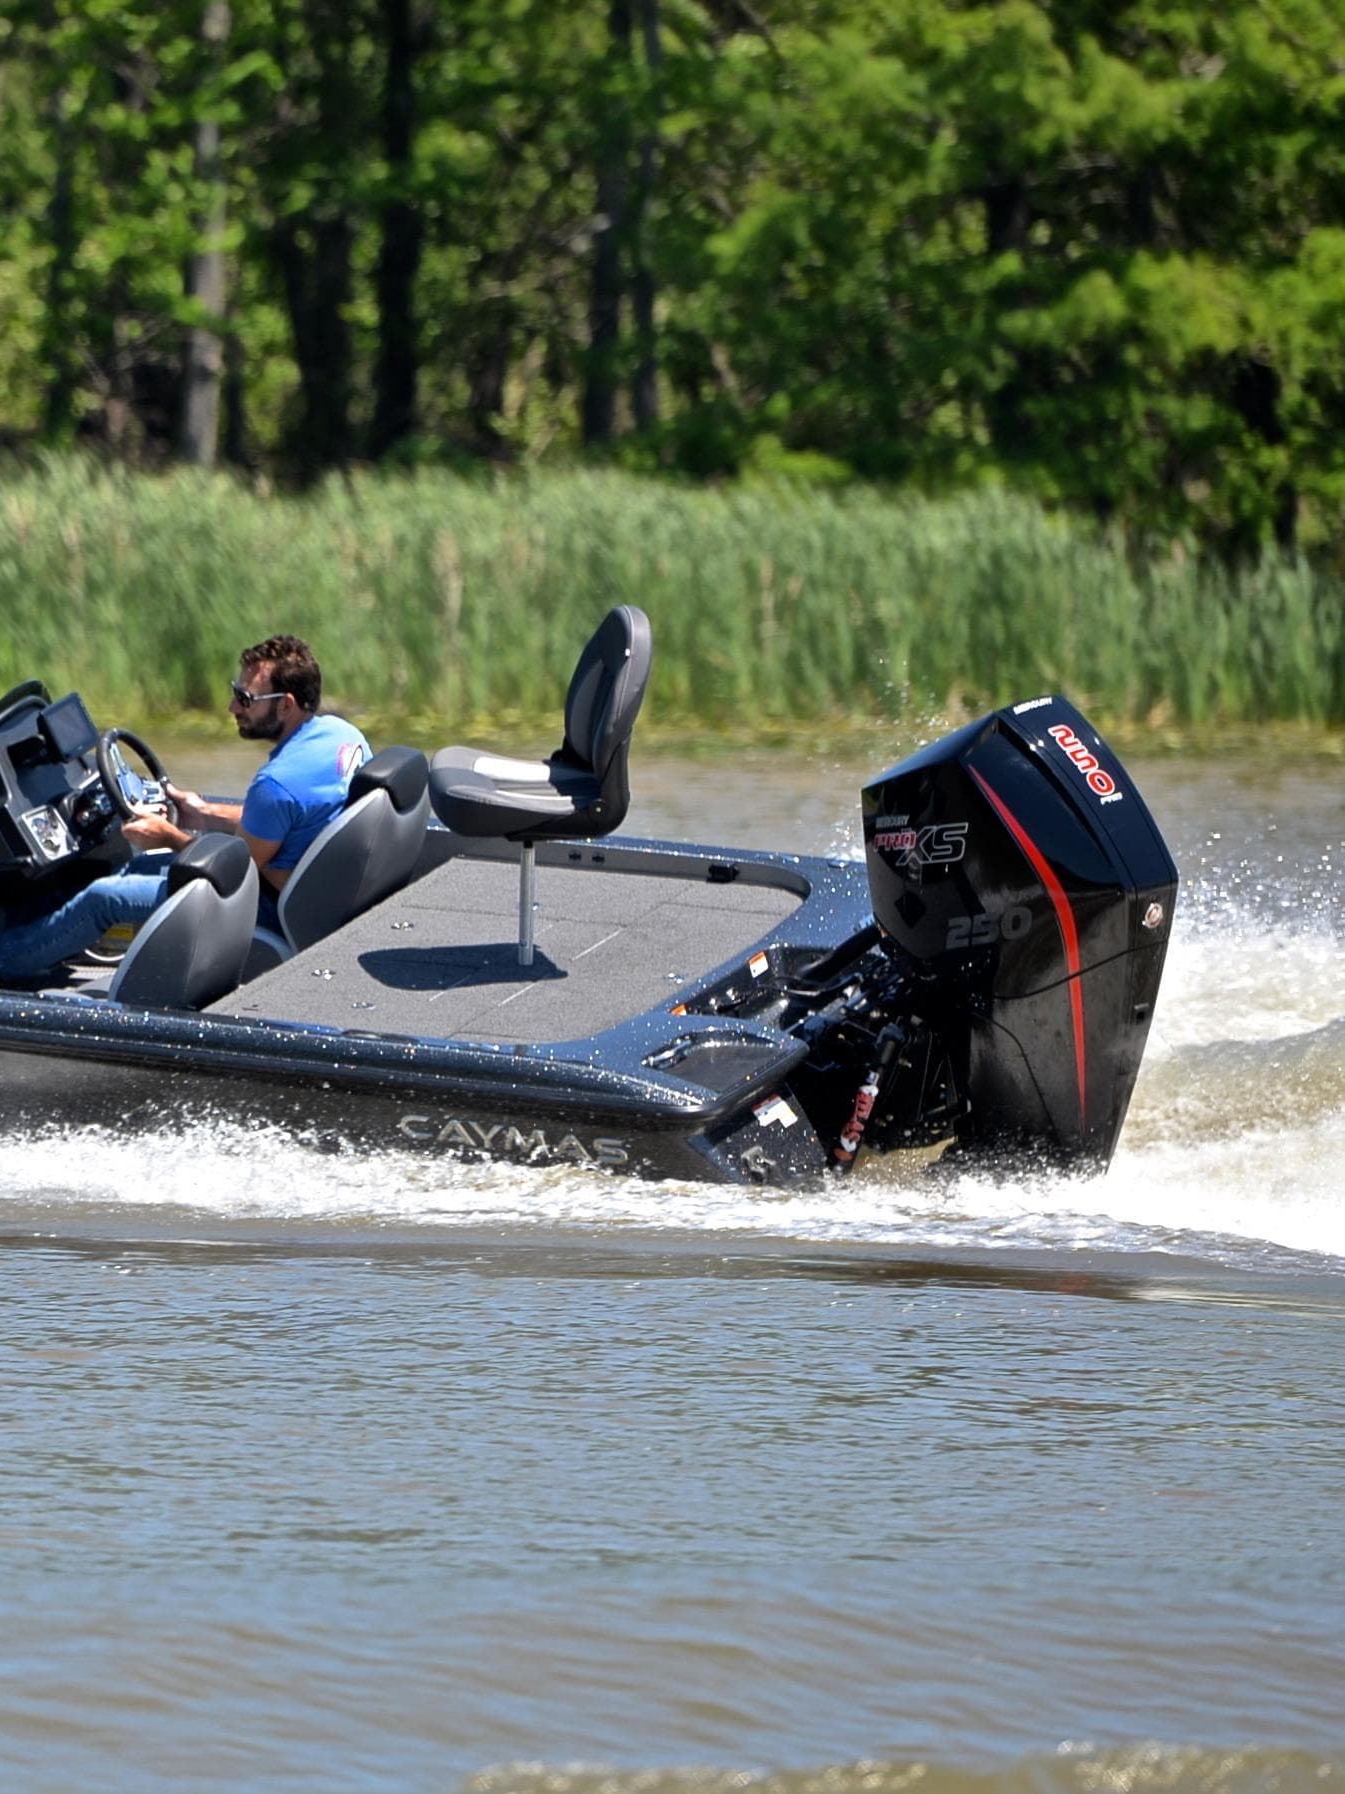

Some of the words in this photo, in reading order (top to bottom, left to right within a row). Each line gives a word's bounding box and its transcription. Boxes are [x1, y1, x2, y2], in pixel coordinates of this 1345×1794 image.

[1048, 724, 1117, 797] 250
[873, 831, 918, 852] PRO
[875, 815, 911, 829] MERCURY
[895, 822, 969, 866] XS
[945, 906, 1032, 949] 250
[397, 1115, 629, 1165] CAYMAS
